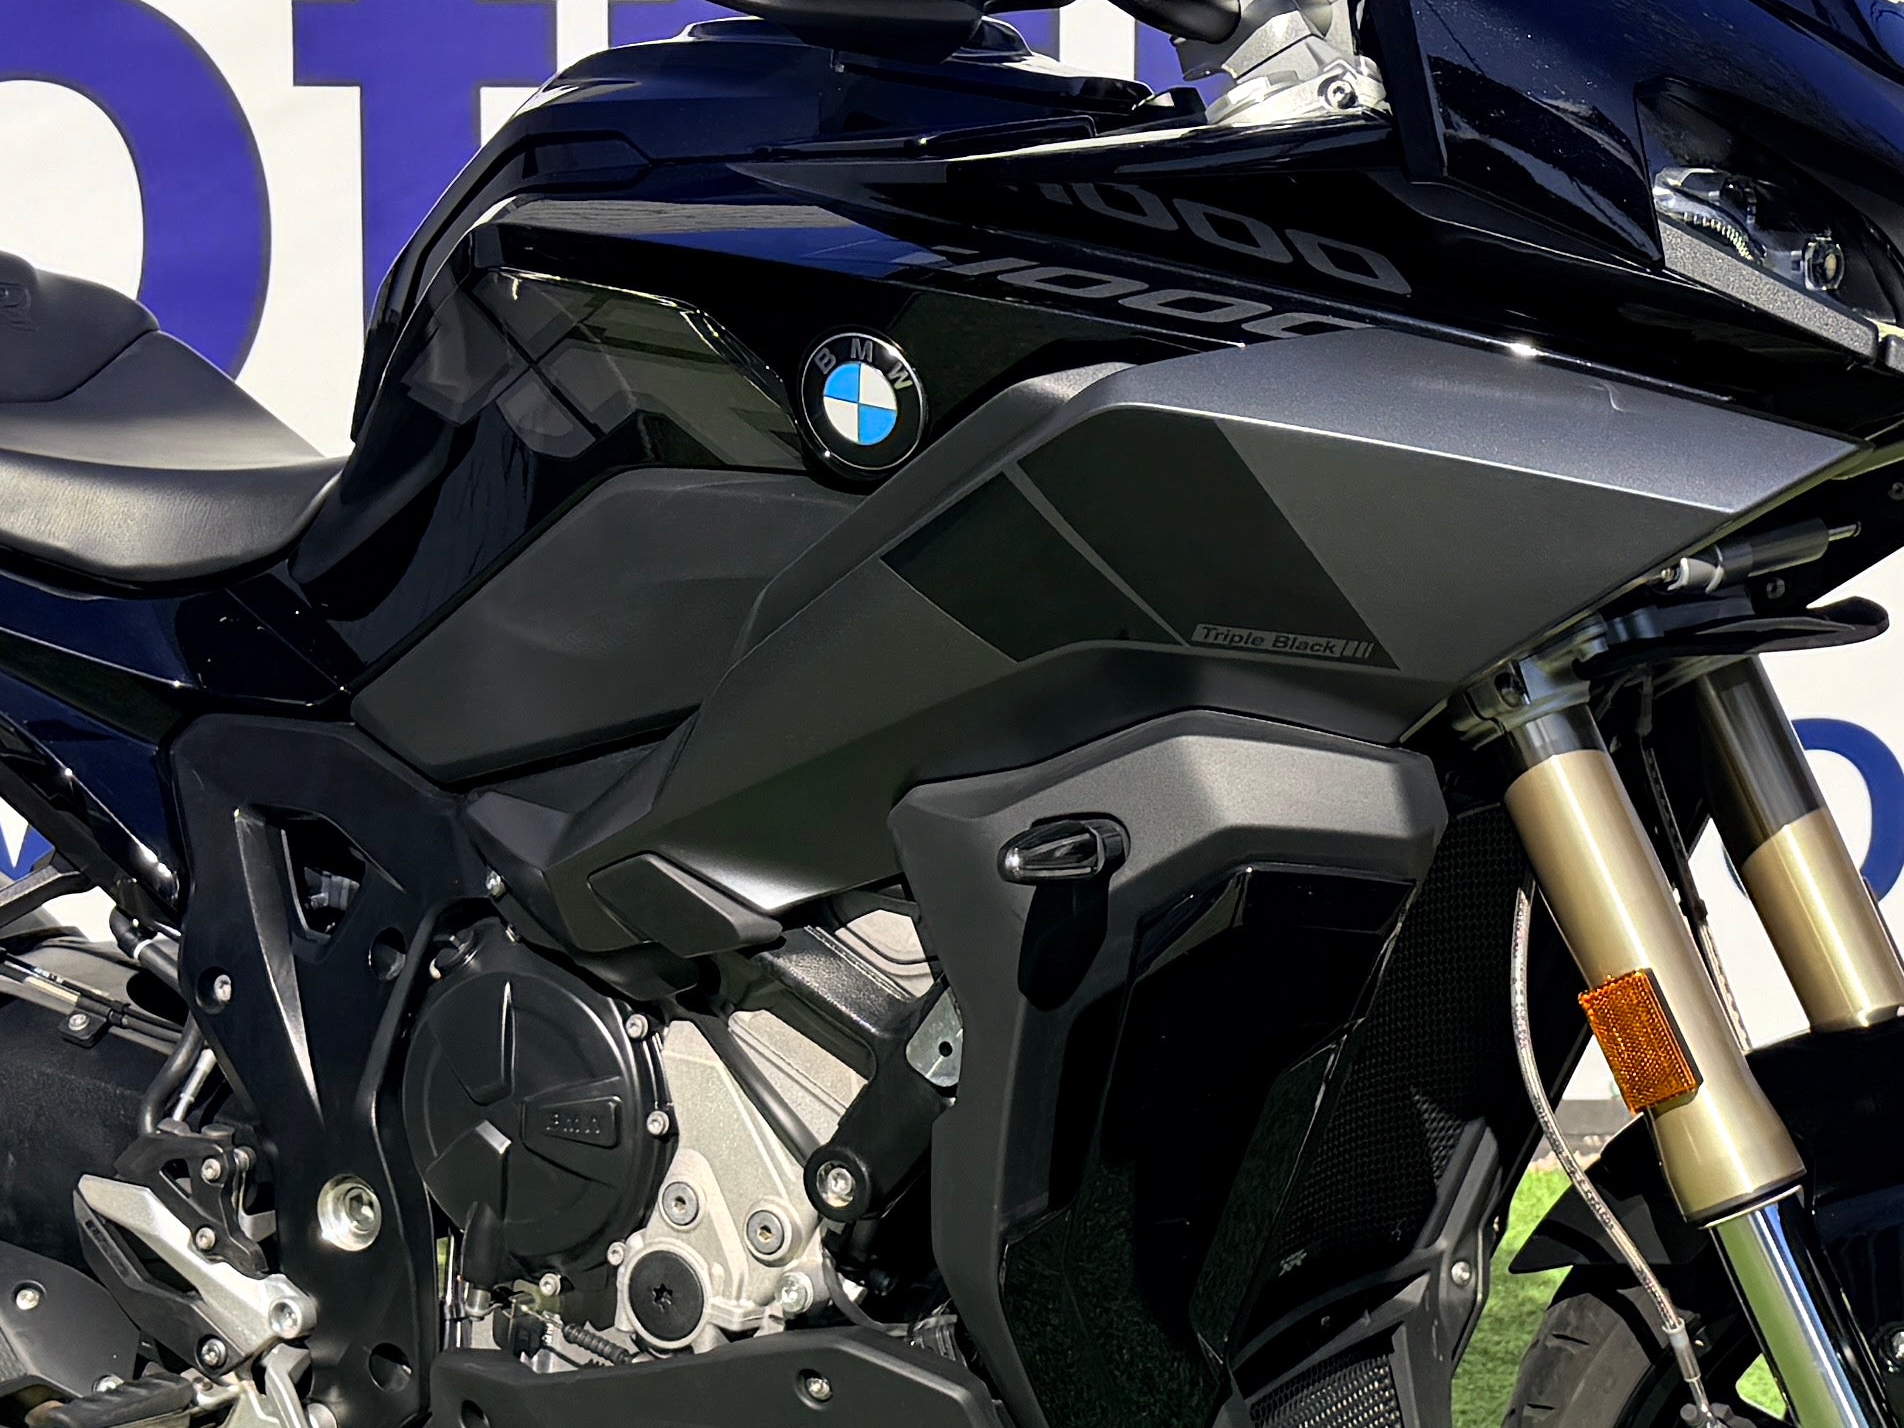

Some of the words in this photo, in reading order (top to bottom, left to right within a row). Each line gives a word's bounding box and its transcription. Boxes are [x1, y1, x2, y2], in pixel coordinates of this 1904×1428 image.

[813, 337, 914, 390] BMW
[1202, 626, 1265, 648] Triple
[1271, 634, 1337, 654] Black
